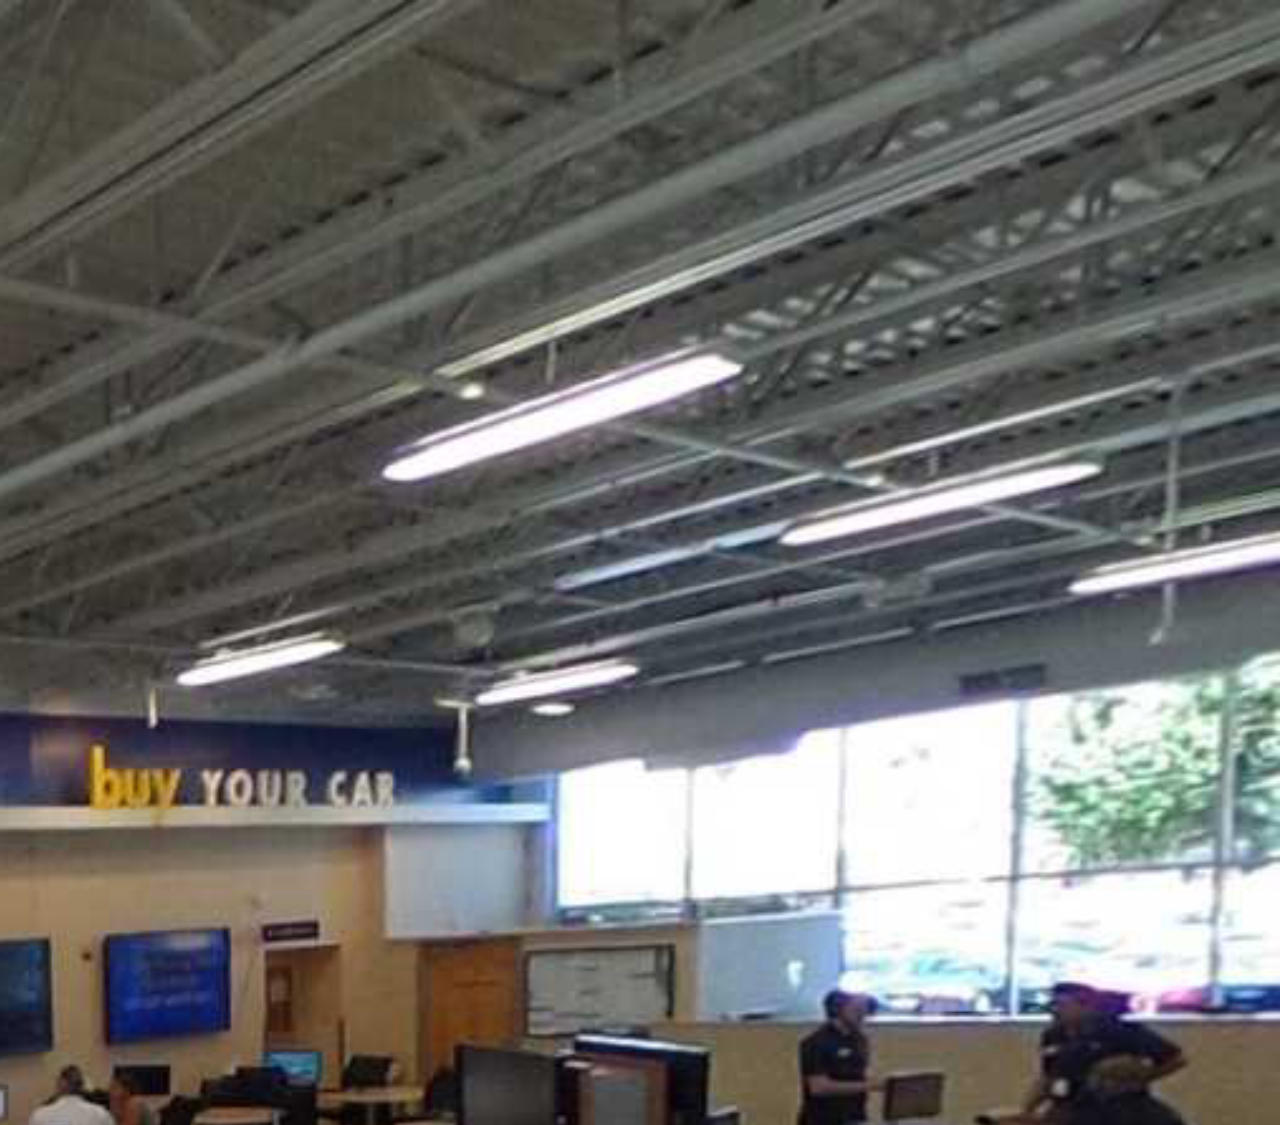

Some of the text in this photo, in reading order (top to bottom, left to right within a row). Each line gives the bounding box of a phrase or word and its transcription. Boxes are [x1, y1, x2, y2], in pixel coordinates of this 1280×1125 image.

[92, 745, 396, 809] buy YOUR CAR
